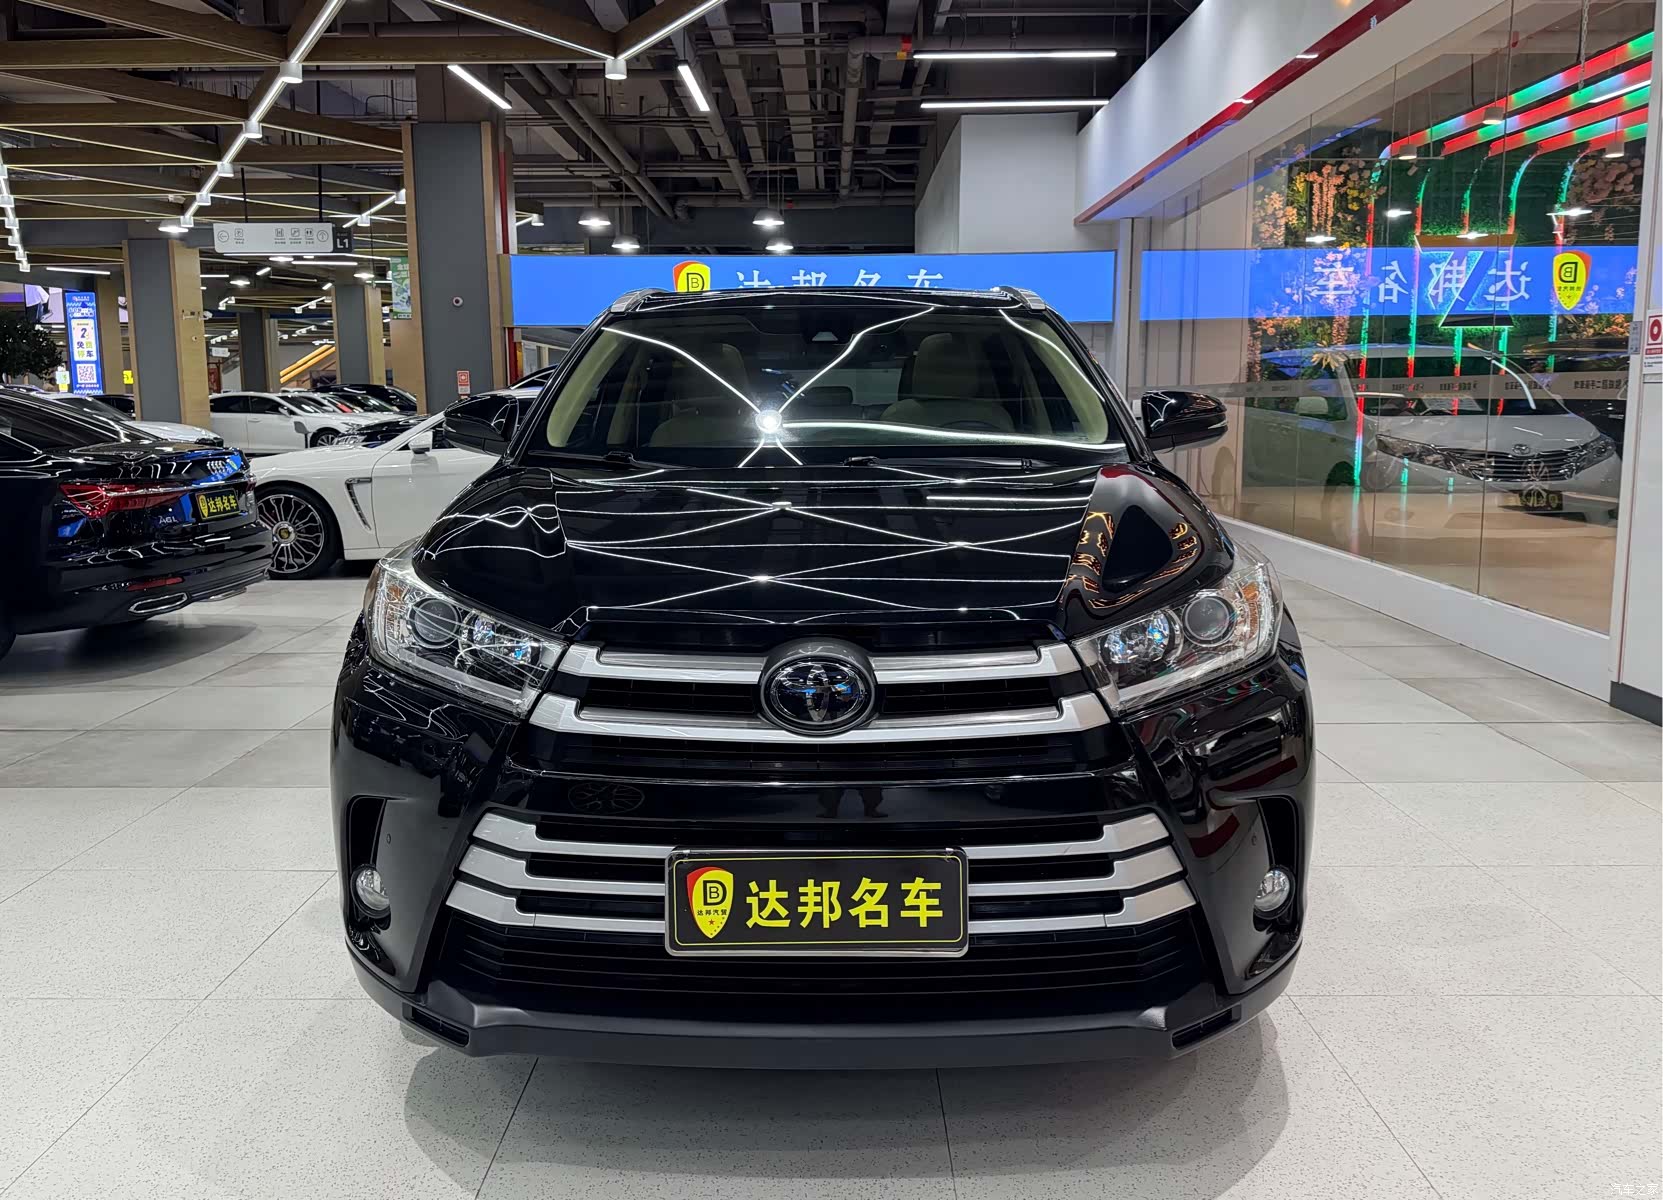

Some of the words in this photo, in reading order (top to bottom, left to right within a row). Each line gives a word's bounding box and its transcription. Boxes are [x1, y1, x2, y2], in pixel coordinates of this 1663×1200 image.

[336, 238, 349, 248] L1
[207, 494, 237, 512] 达邦名车
[745, 876, 943, 928] 达邦名车
